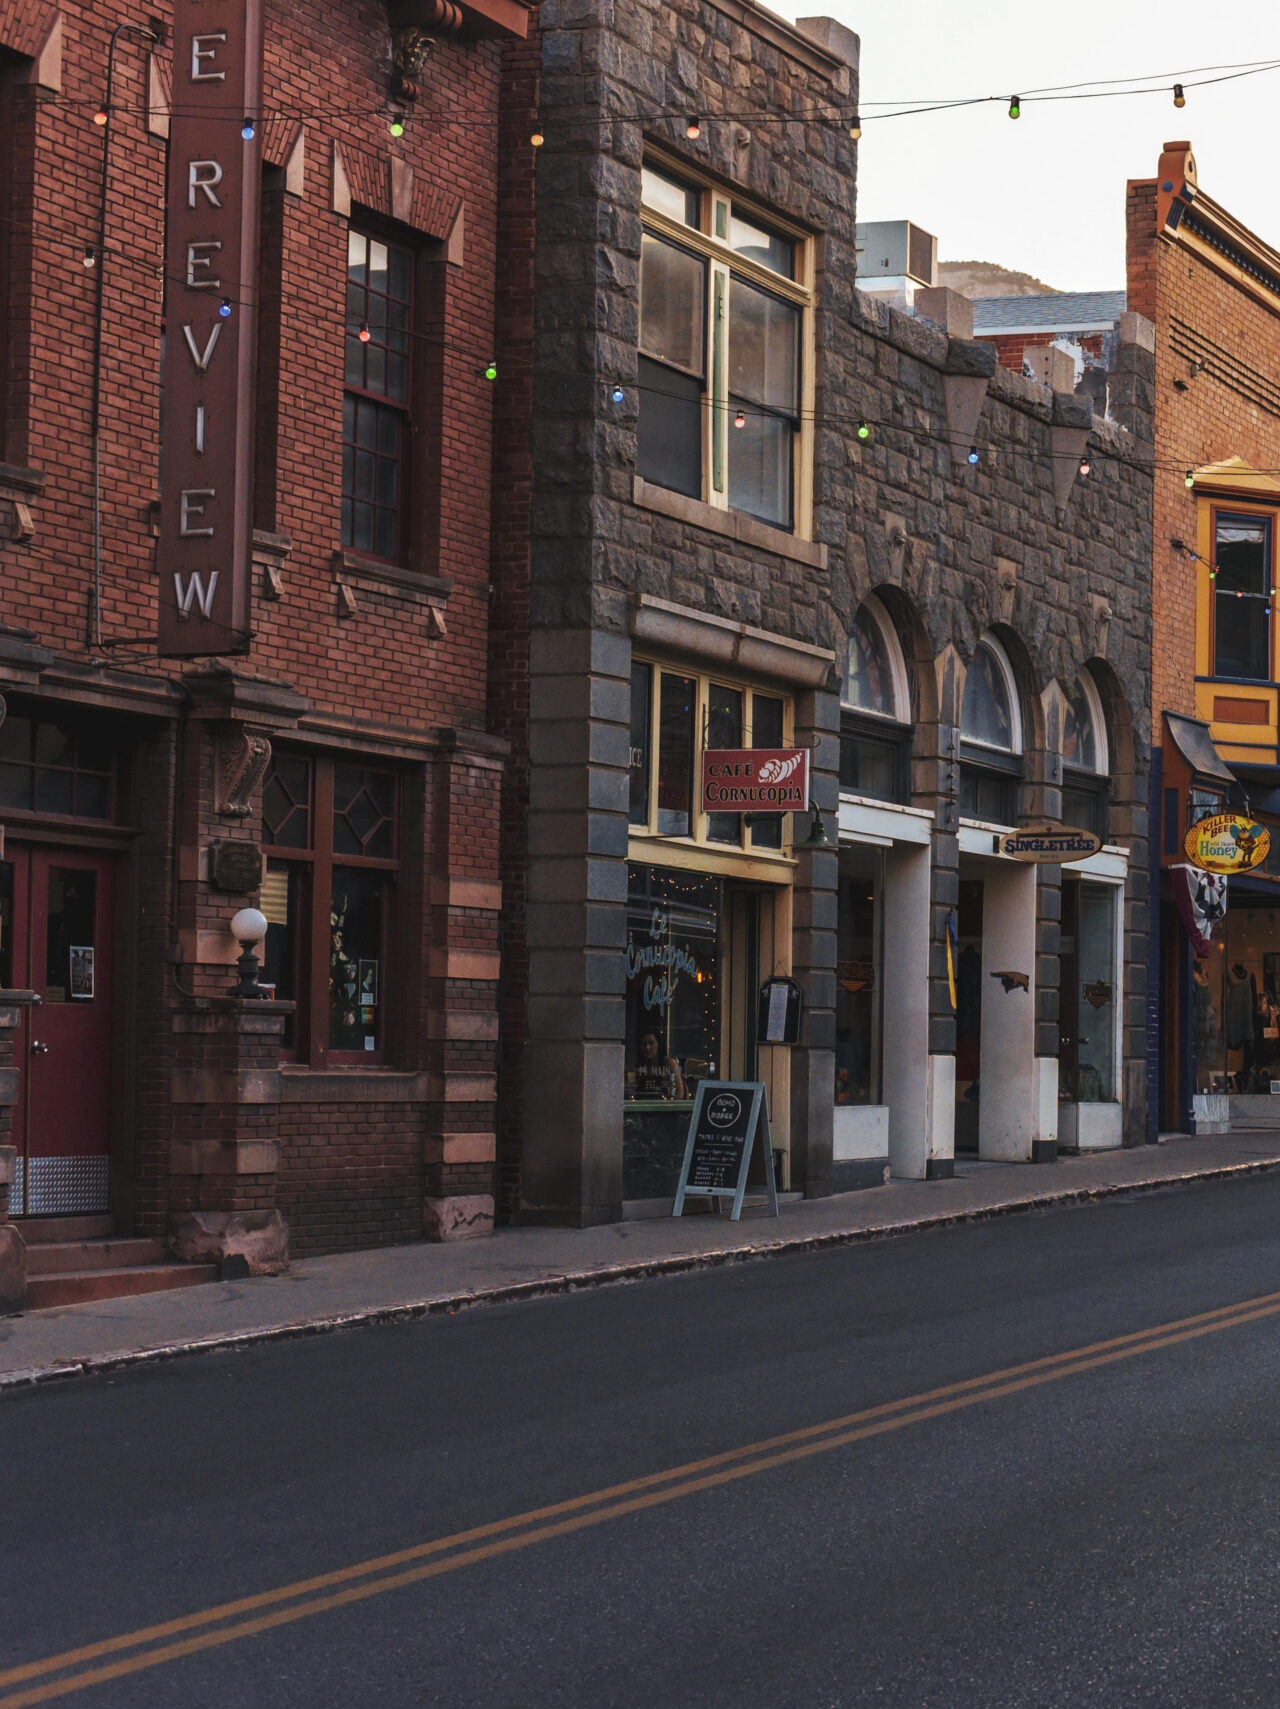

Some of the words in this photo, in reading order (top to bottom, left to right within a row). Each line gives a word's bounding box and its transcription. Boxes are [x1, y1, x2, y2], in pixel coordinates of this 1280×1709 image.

[173, 159, 224, 621] REVIEW
[1203, 815, 1237, 835] KILLER
[1211, 824, 1229, 838] BEE
[1005, 838, 1095, 854] SINGLETREE
[1200, 840, 1238, 859] Honey
[649, 907, 668, 939] Le
[625, 943, 698, 979] Cornucopia
[644, 975, 679, 1017] Café
